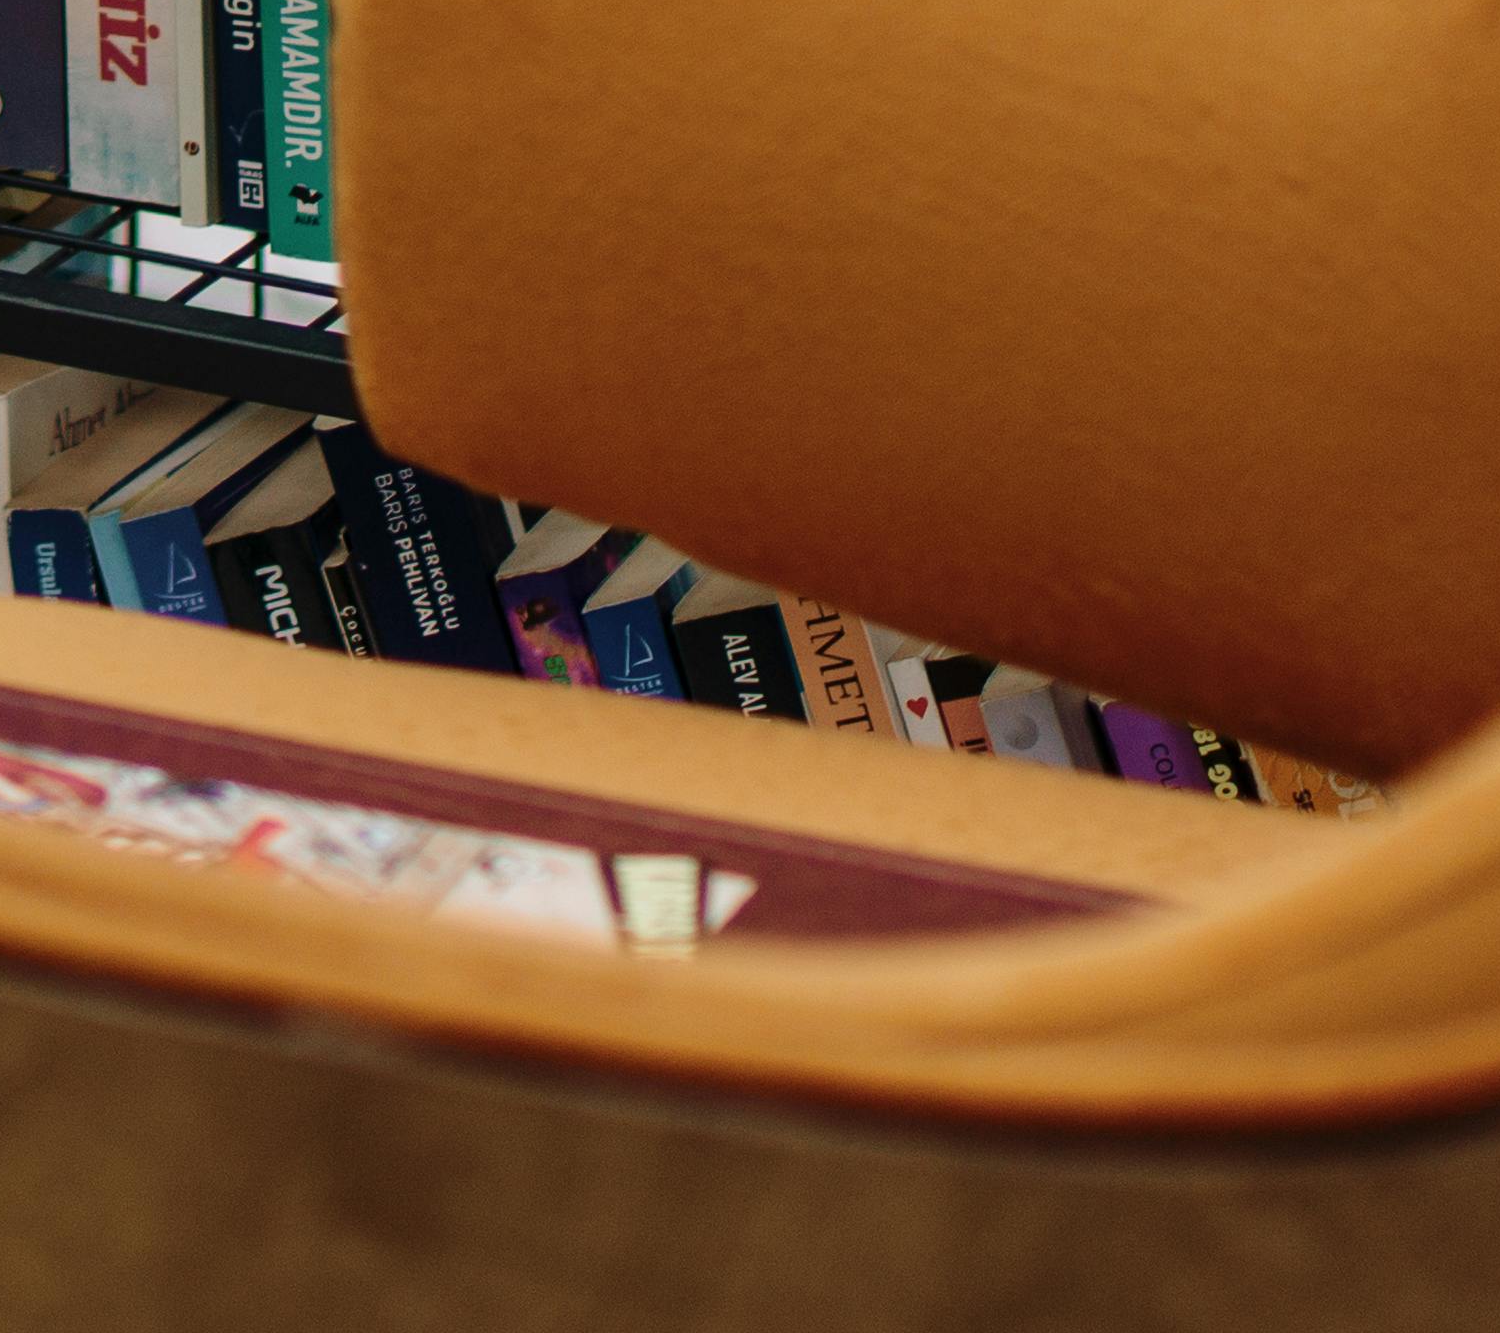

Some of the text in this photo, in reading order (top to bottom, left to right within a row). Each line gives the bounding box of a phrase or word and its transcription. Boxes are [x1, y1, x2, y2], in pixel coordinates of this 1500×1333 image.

[373, 472, 409, 535] BARIŞ
[397, 466, 464, 634] BARIŞ TERKOĞLU
[338, 603, 370, 659] Çocu
[721, 633, 762, 685] ALEV
[799, 596, 877, 734] HMET
